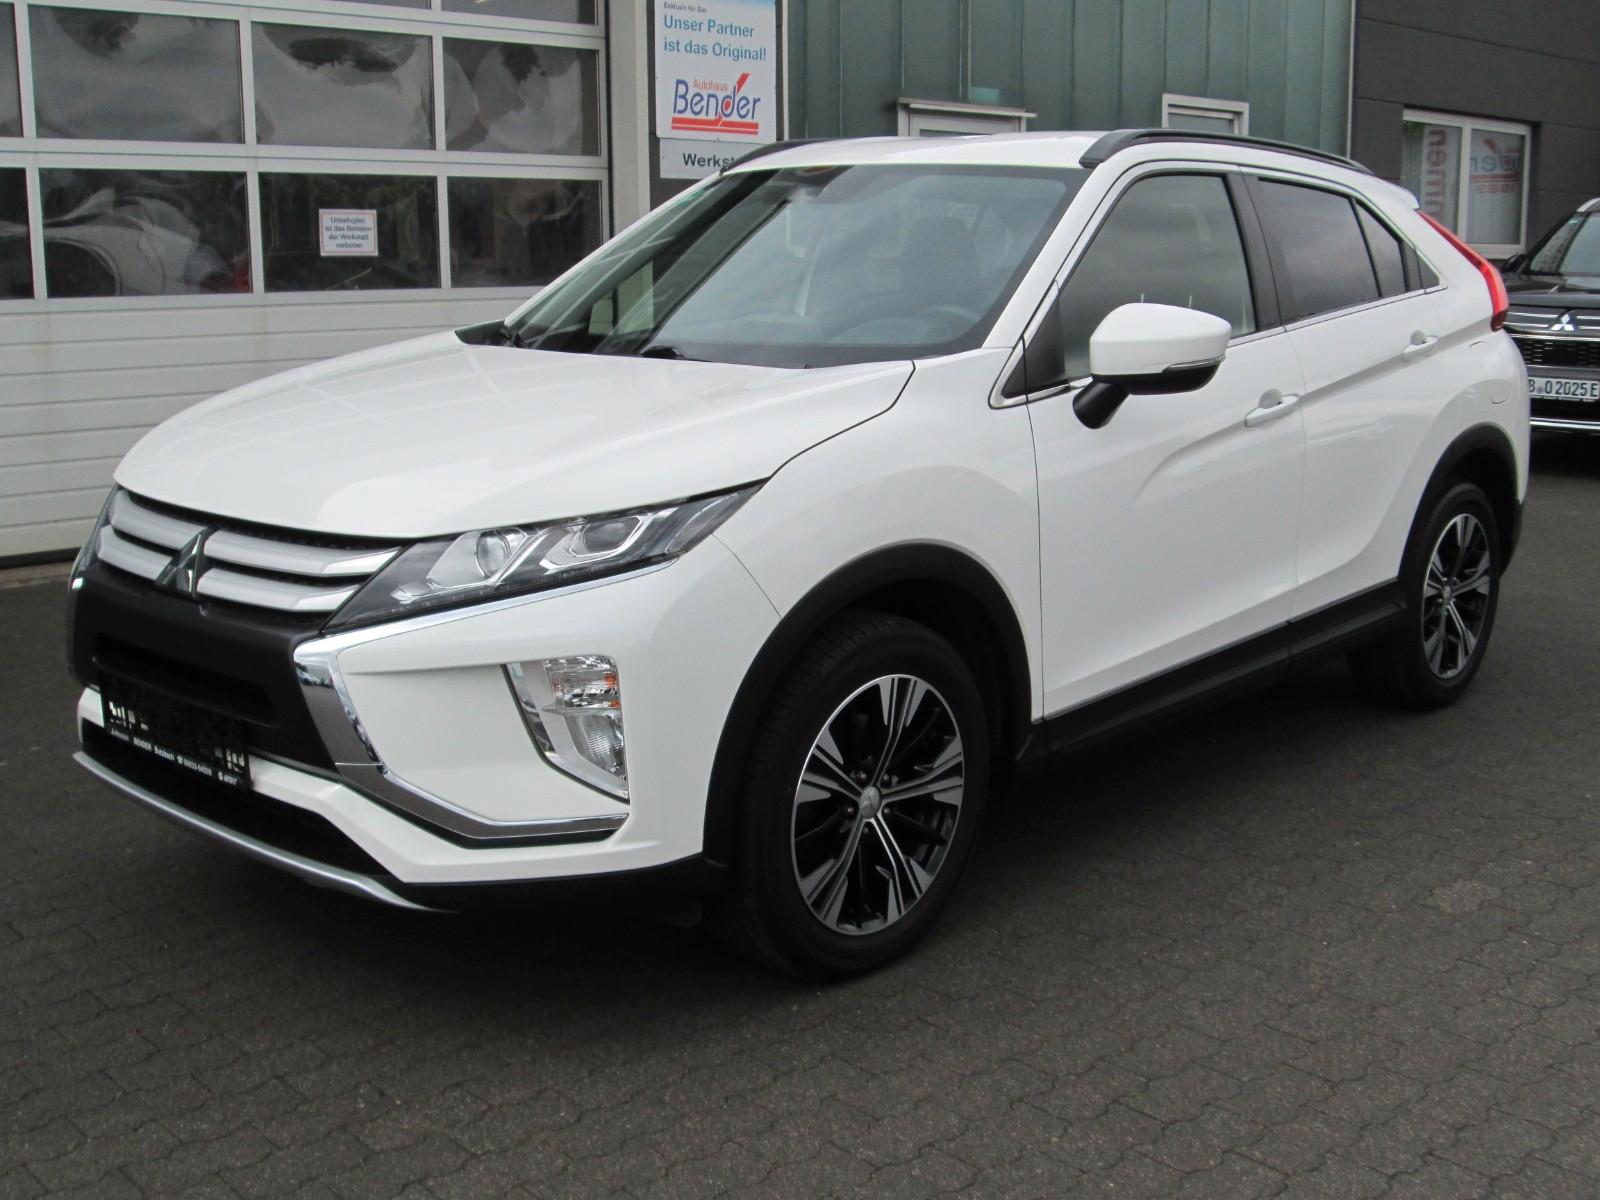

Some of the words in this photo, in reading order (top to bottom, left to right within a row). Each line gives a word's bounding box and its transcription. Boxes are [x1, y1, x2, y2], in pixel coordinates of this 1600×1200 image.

[663, 14, 704, 32] Unser
[707, 19, 755, 38] Partner
[663, 37, 680, 52] ist
[684, 40, 708, 56] das
[712, 42, 767, 62] Original!
[692, 79, 729, 92] Autohaus
[672, 78, 761, 120] Bender
